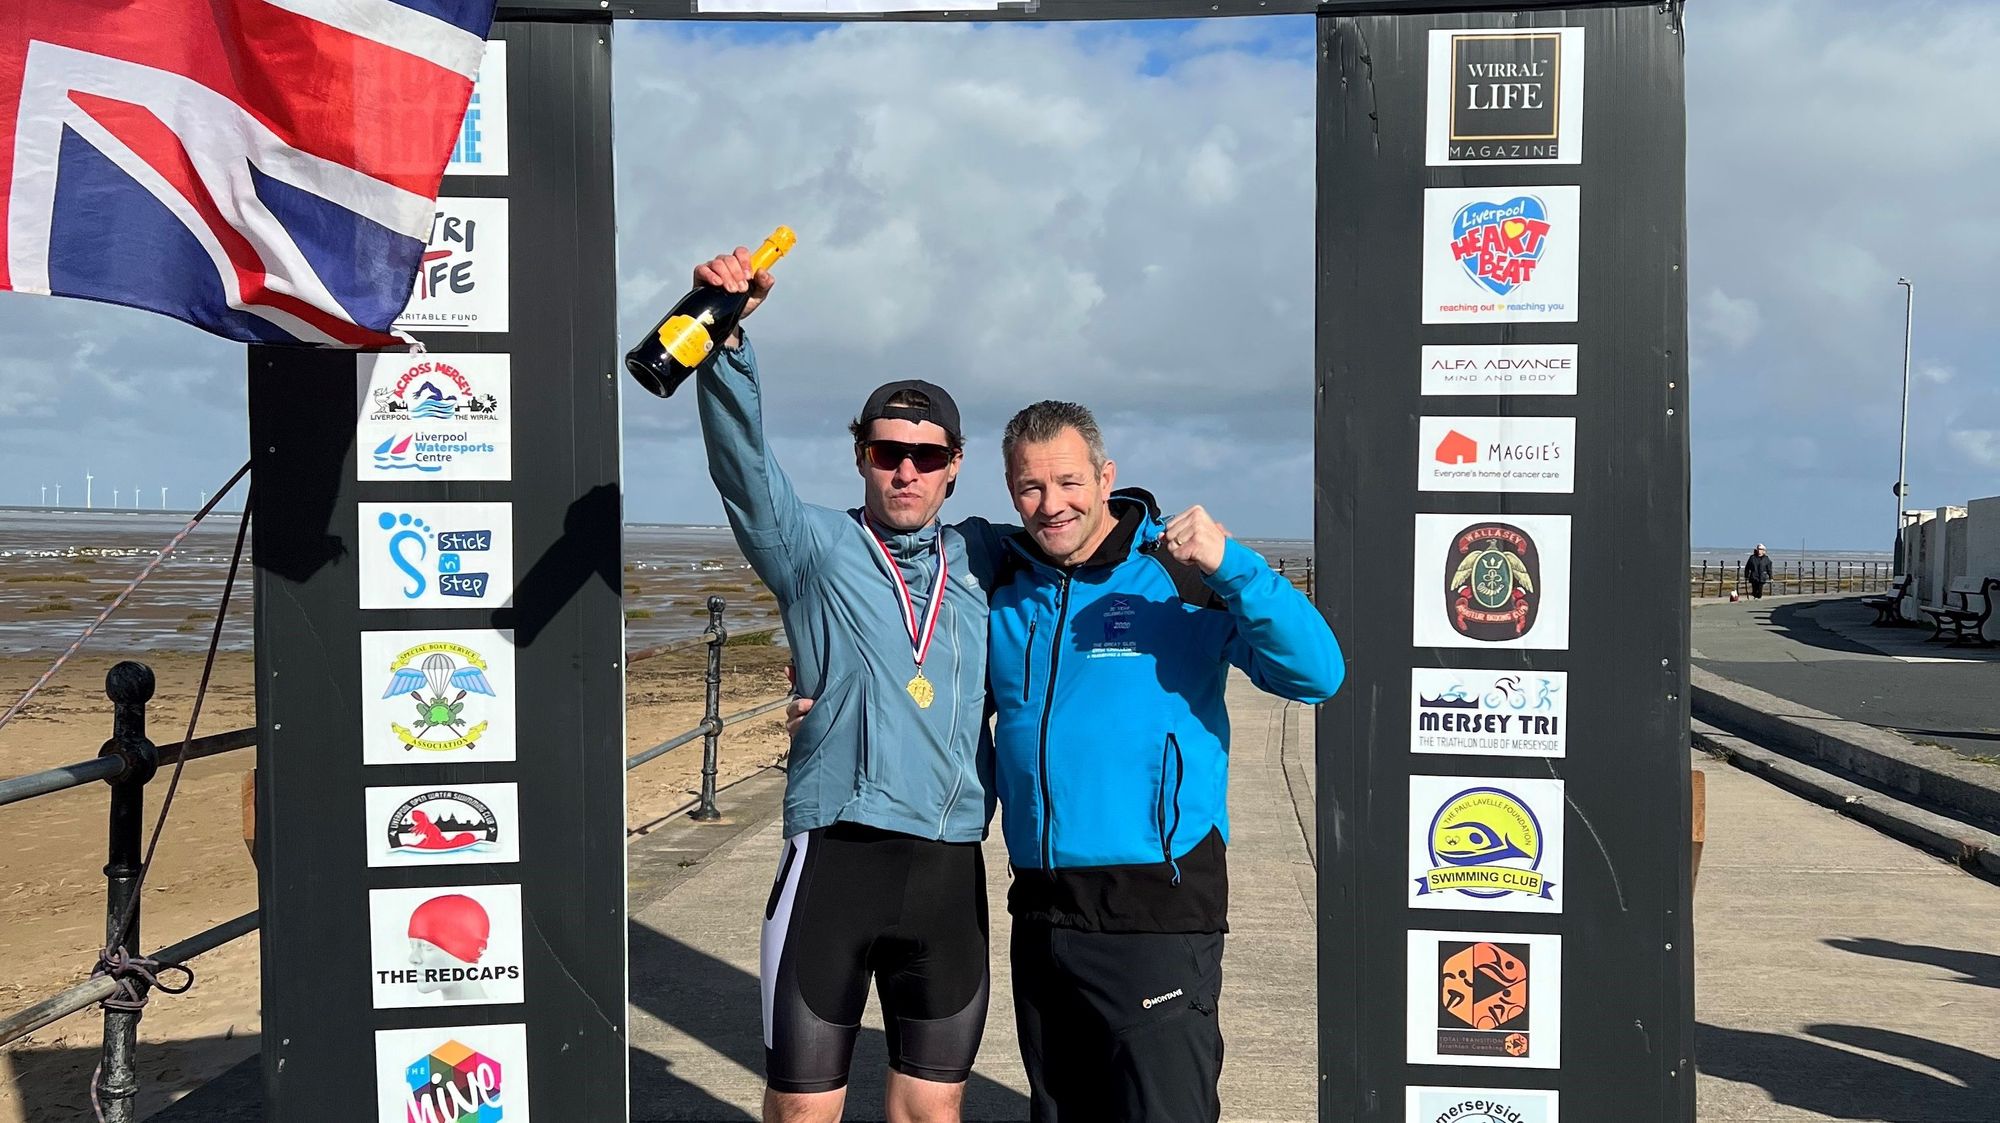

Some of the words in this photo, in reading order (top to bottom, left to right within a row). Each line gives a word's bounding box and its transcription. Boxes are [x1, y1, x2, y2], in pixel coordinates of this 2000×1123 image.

[1468, 63, 1544, 78] WIRRAL
[1467, 83, 1543, 110] LIFE
[1450, 145, 1558, 158] MAGAZINE
[1462, 201, 1525, 228] Liverpool
[1450, 217, 1551, 260] HEART
[1478, 250, 1536, 284] BEAT
[1440, 304, 1478, 313] reaching
[1507, 302, 1546, 312] reaching
[1548, 303, 1564, 311] you
[1432, 360, 1478, 370] ALFA
[1484, 359, 1572, 370] ADVANCE
[393, 362, 432, 399] ACROSS
[434, 362, 473, 397] MERSEY
[415, 432, 468, 443] Liverpool
[415, 442, 494, 454] Watersports
[1488, 442, 1560, 461] MAGGIE'S
[415, 453, 452, 462] Centre
[1434, 470, 1476, 478] Everyone's
[1478, 470, 1501, 478] home
[1502, 470, 1511, 478] of
[440, 533, 489, 550] Stick
[1464, 530, 1522, 544] WALLASEY
[445, 559, 456, 570] n
[440, 575, 485, 597] Step
[400, 645, 426, 660] SPECIAL
[449, 644, 476, 659] SERVICE
[1420, 712, 1512, 734] MERSEY
[1518, 715, 1558, 735] TRI
[412, 738, 468, 749] ASSOCIATION
[1420, 736, 1434, 746] THE
[1436, 737, 1478, 748] TRIATHLON
[1479, 738, 1499, 749] CLUB
[1500, 739, 1510, 749] OF
[1512, 740, 1558, 751] MERSEYSIDE
[428, 792, 452, 800] WATER
[1444, 812, 1456, 824] THE
[1455, 802, 1473, 814] PAUL
[1472, 798, 1502, 808] LAVELLE
[1503, 804, 1532, 846] FOUNDATION
[1431, 872, 1499, 884] SWIMMING
[1502, 874, 1538, 888] CLUB
[377, 970, 418, 984] THE
[425, 965, 520, 982] REDCAPS
[1151, 989, 1183, 1004] MONTANE
[1462, 1036, 1504, 1044] TRANSITION
